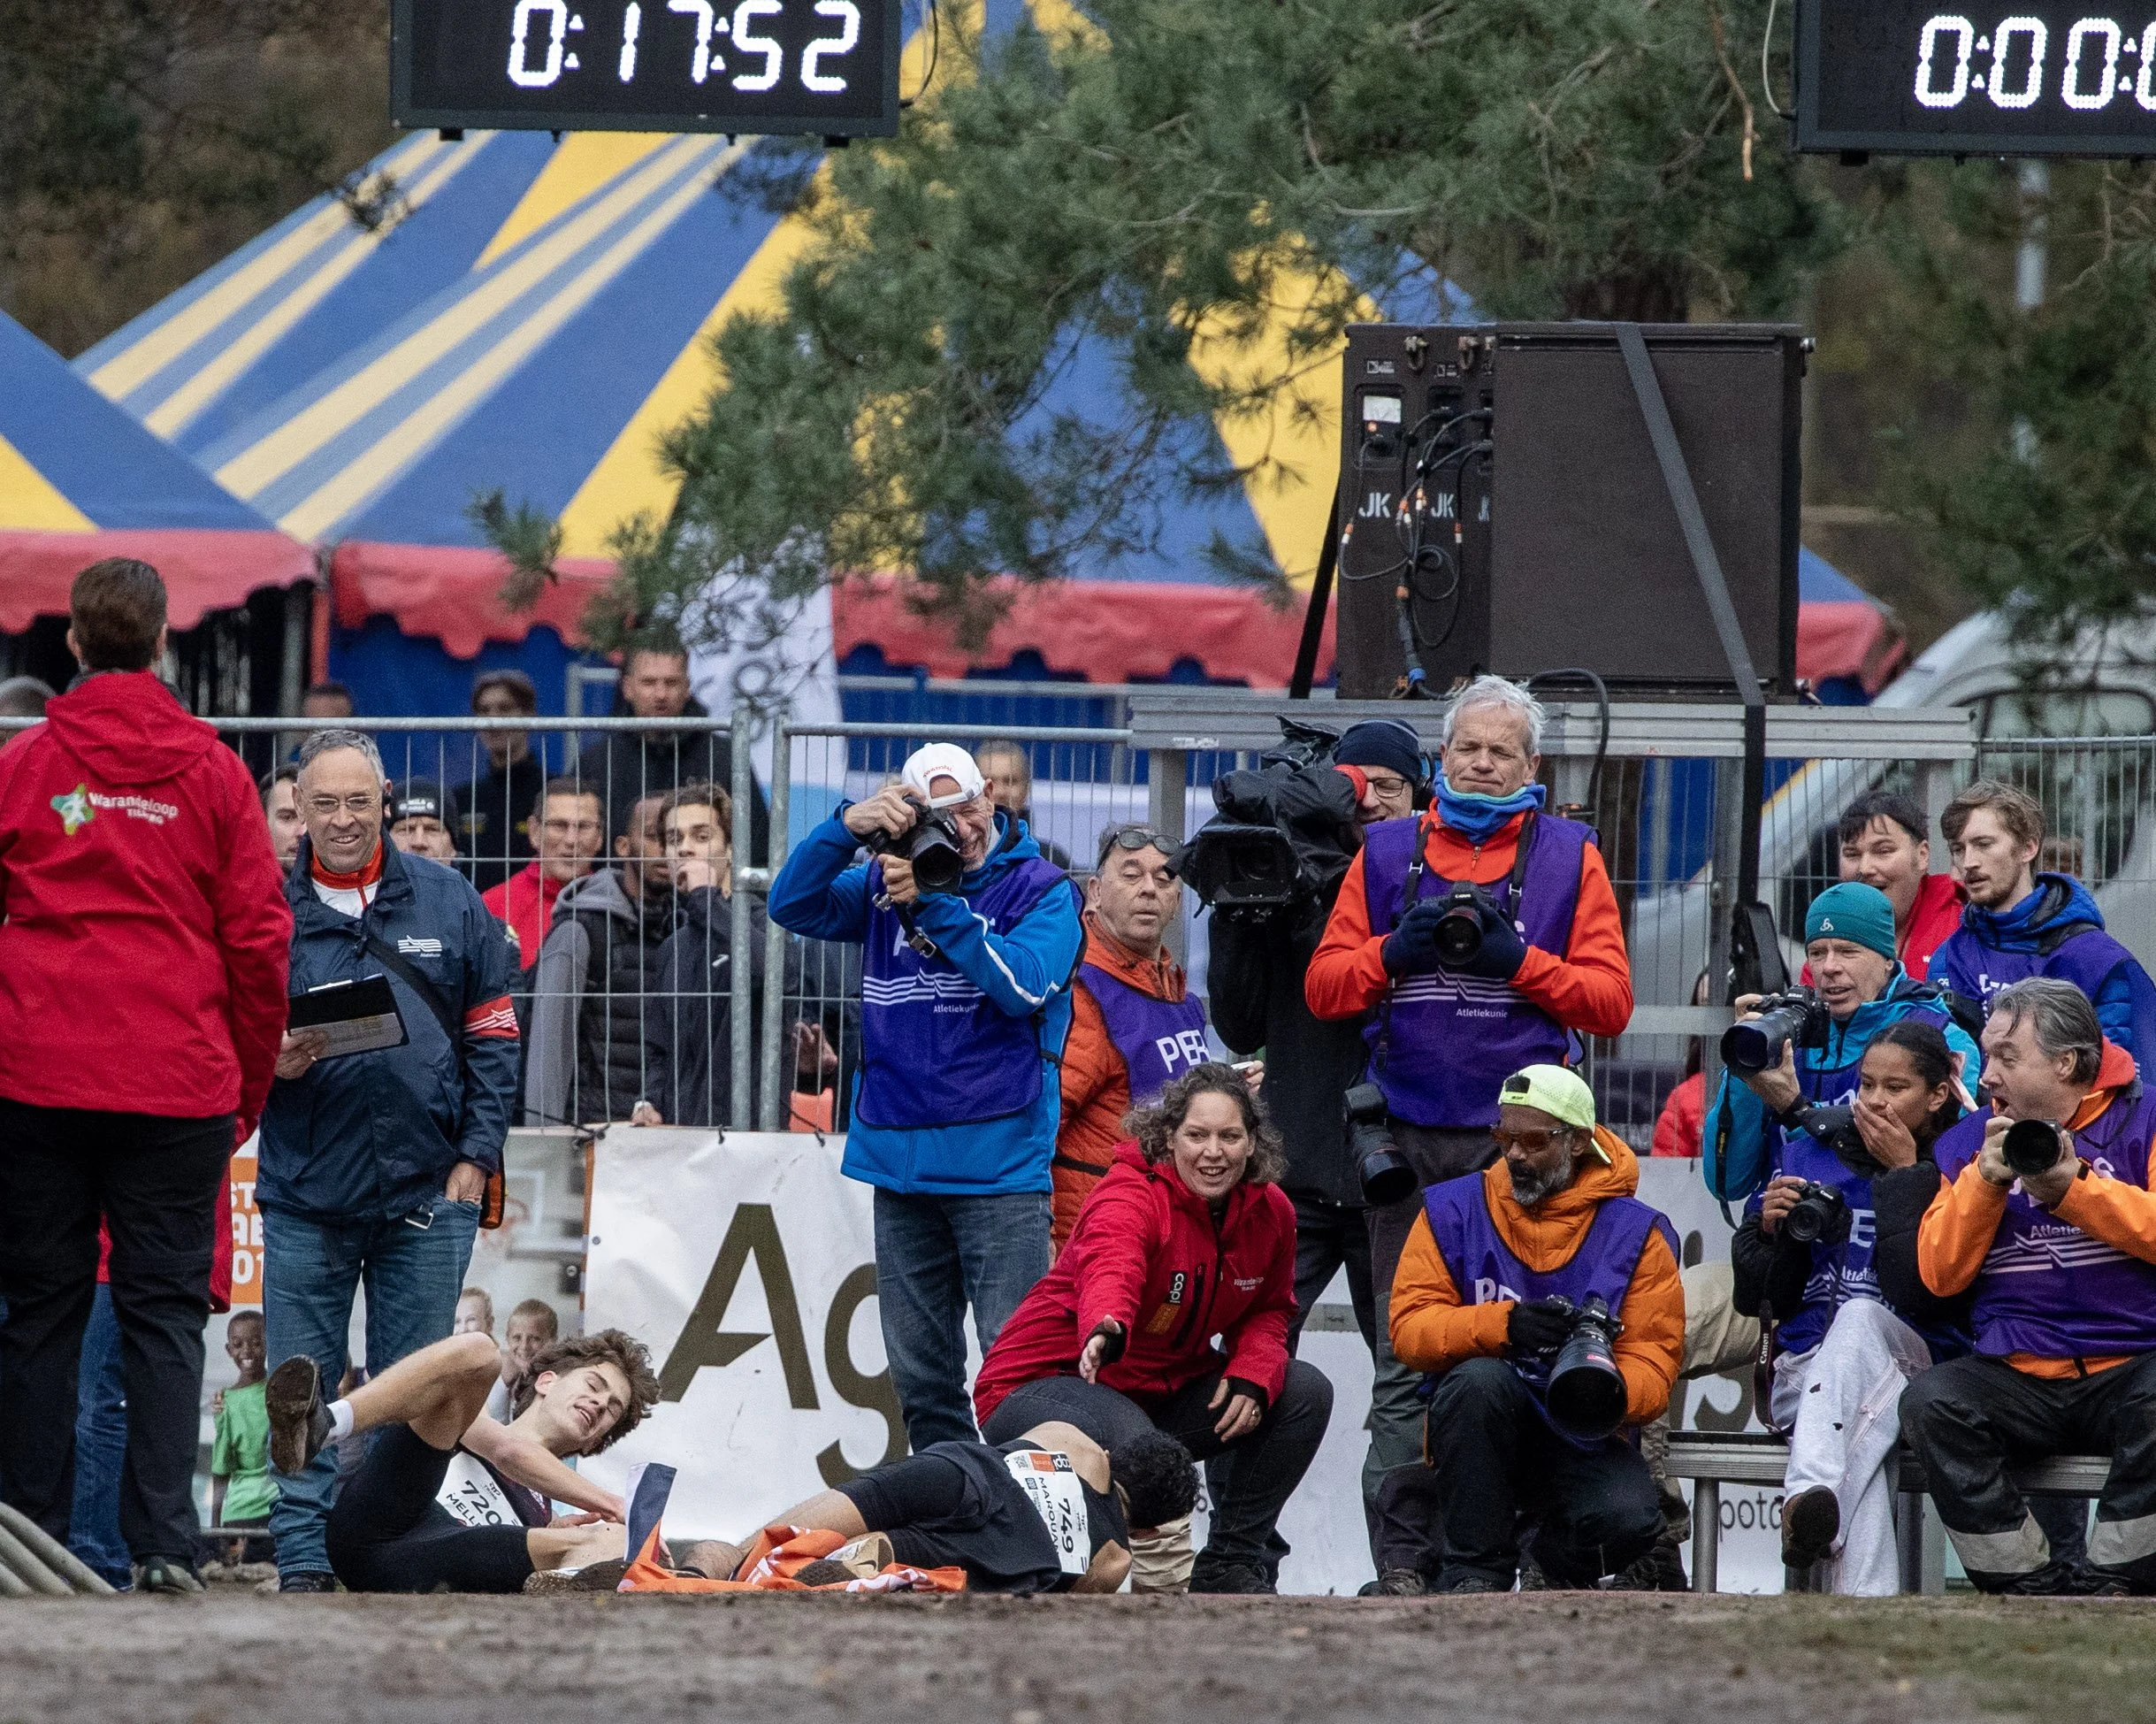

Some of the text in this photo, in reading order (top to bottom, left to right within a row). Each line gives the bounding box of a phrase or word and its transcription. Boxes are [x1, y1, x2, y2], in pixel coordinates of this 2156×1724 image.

[507, 0, 861, 91] 0:17:52
[1358, 492, 1391, 518] JK
[1430, 493, 1455, 518] JK
[1760, 1332, 1770, 1364] Canon
[1058, 1498, 1074, 1553] 749
